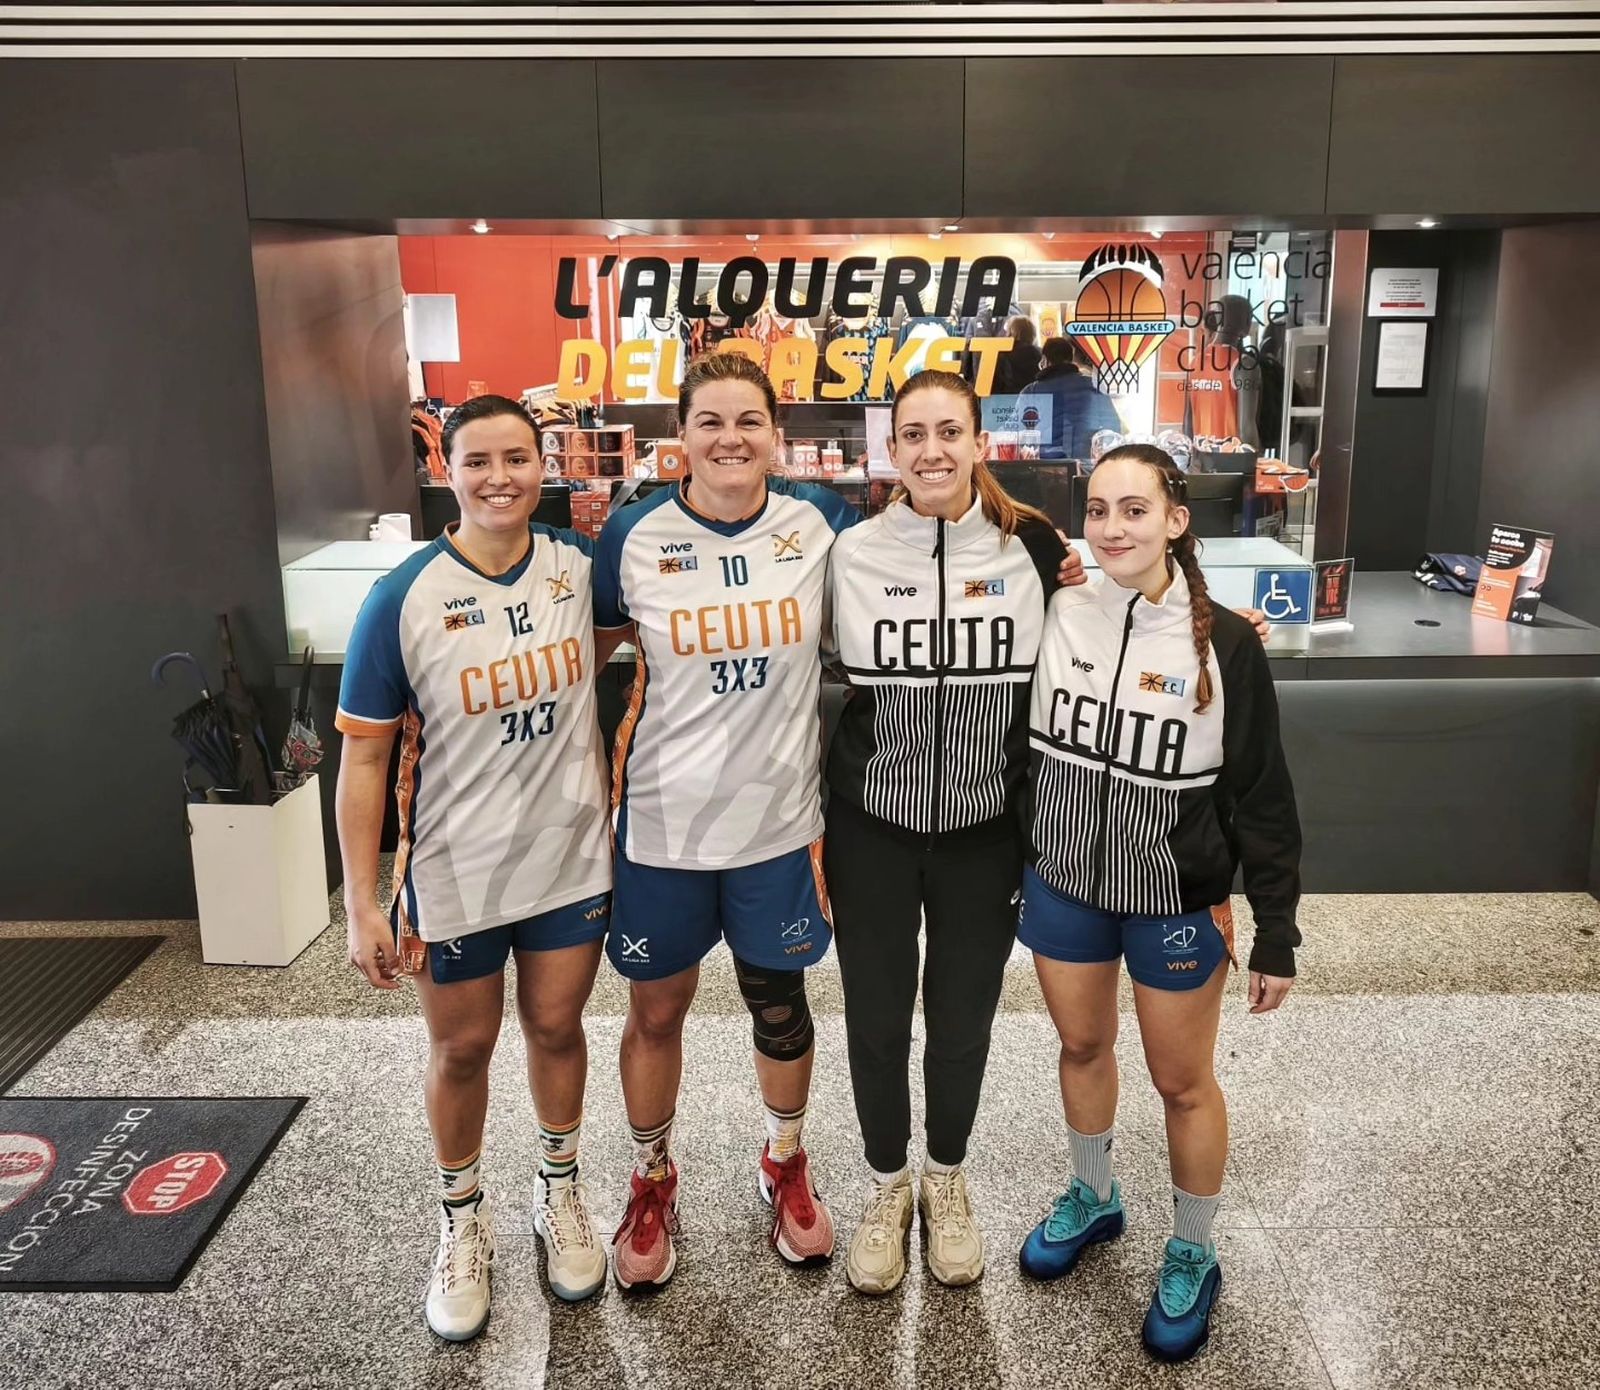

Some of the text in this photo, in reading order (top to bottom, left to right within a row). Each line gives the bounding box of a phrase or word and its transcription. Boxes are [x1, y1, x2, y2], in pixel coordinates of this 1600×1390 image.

[1181, 240, 1332, 280] valencia
[554, 255, 1017, 328] L'ALQUERIA
[1181, 289, 1304, 328] baket
[1072, 322, 1169, 333] VALENCIA BASKET
[556, 338, 681, 401] DEL
[1177, 335, 1260, 372] club
[660, 542, 693, 554] vive
[718, 555, 748, 587] 10
[444, 595, 477, 610] vive
[884, 585, 917, 597] vive
[504, 602, 534, 637] 12
[670, 597, 802, 656] CEUTA
[873, 616, 1014, 671] CEUTA
[460, 637, 582, 715] CEUTA
[710, 656, 769, 694] 3X3
[1071, 657, 1095, 672] vive
[1049, 688, 1188, 775] CEUTA
[584, 905, 608, 920] viv
[784, 942, 812, 955] vive
[1167, 960, 1198, 970] vive
[0, 1108, 152, 1271] DESINFECCIÓN
[72, 1150, 149, 1215] ZONA
[146, 1156, 206, 1209] STOP
